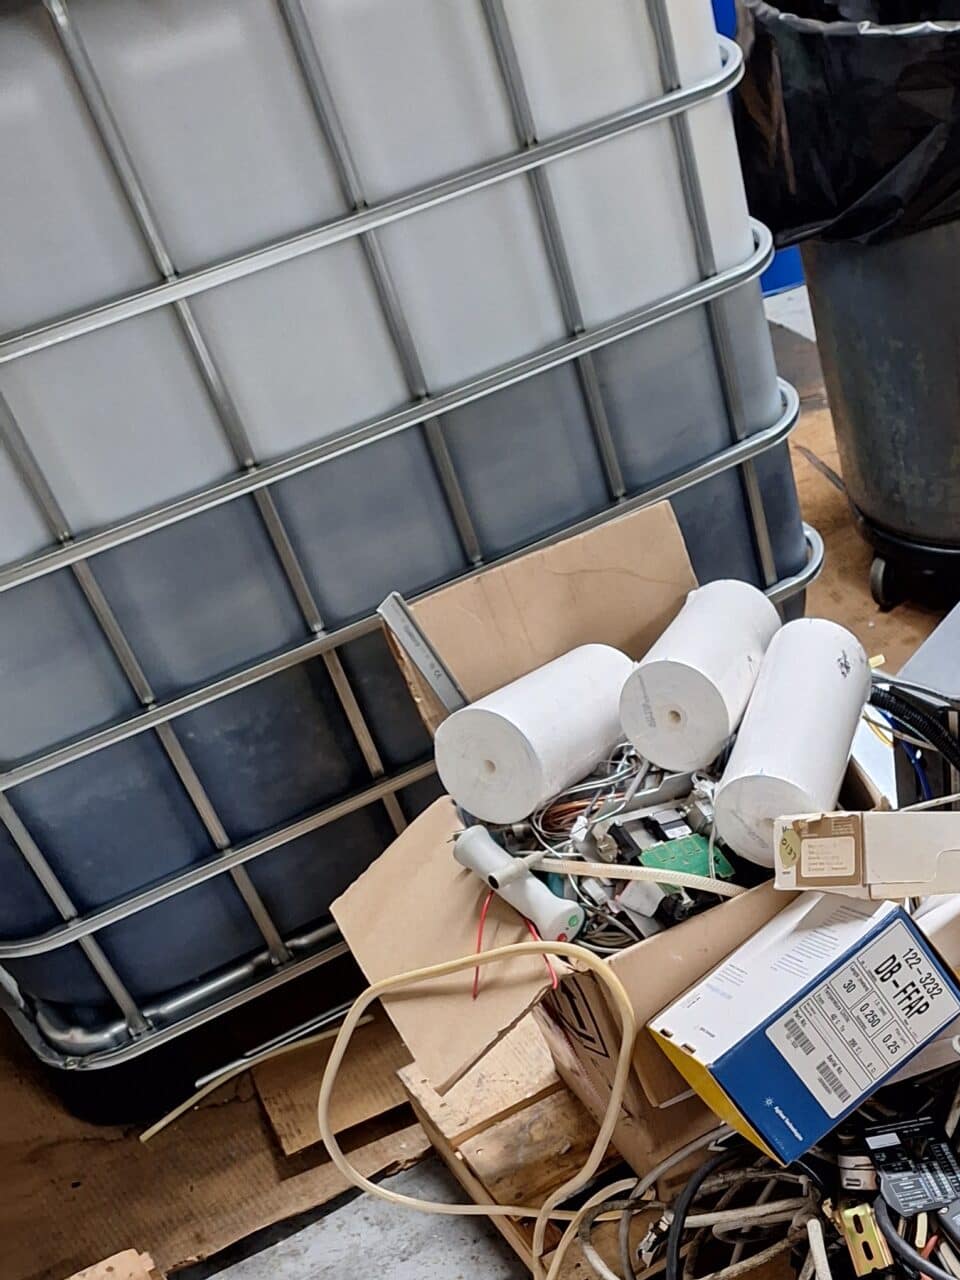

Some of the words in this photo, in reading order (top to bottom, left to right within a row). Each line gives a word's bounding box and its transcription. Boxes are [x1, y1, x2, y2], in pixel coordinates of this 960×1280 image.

[901, 947, 942, 999] 122-3232
[842, 979, 856, 993] 30
[874, 955, 930, 1021] DB-FFAP
[859, 1004, 880, 1027] 0.250
[882, 1034, 899, 1054] 0.25
